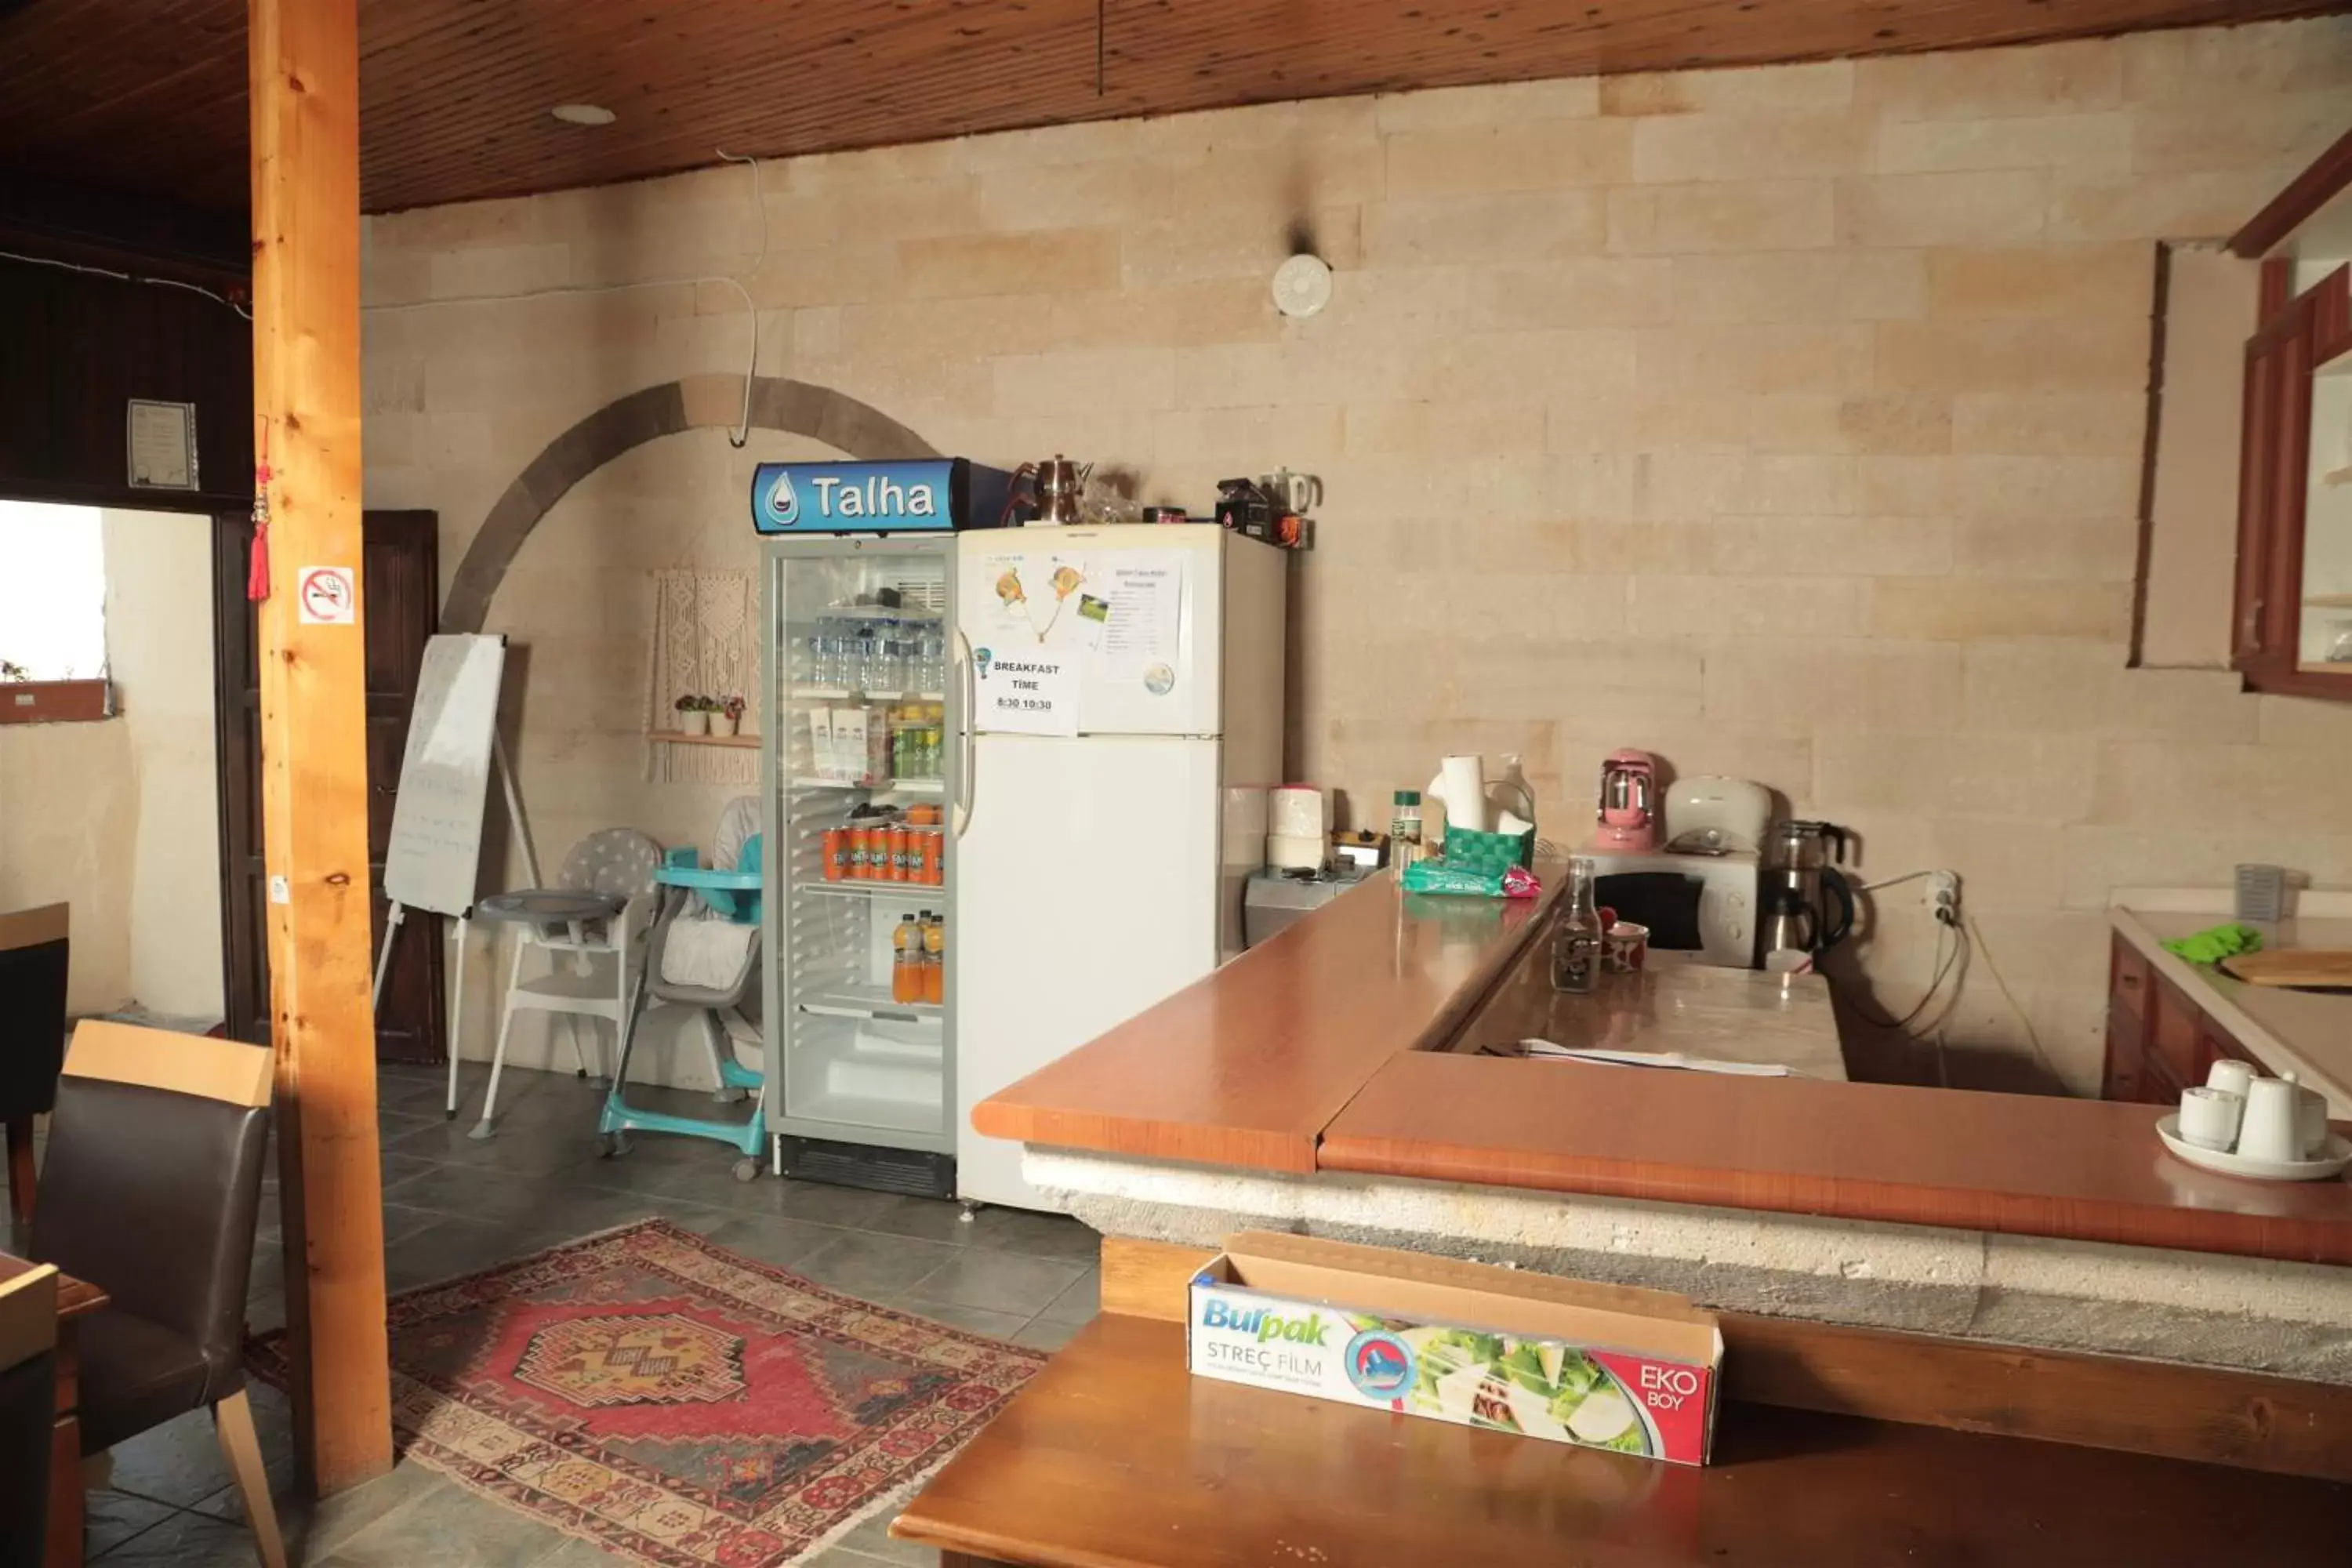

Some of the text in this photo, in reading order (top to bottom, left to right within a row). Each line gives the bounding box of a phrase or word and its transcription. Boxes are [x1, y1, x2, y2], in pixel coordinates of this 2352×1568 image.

[811, 475, 936, 518] Talha
[993, 661, 1060, 674] BREAKFAST
[1022, 699, 1052, 710] 10:30
[1203, 1298, 1330, 1347] Burpak
[1207, 1341, 1272, 1371] STREÇ
[1277, 1352, 1323, 1377] FİLM
[1640, 1364, 1698, 1396] EKO
[1647, 1390, 1685, 1412] BOY
